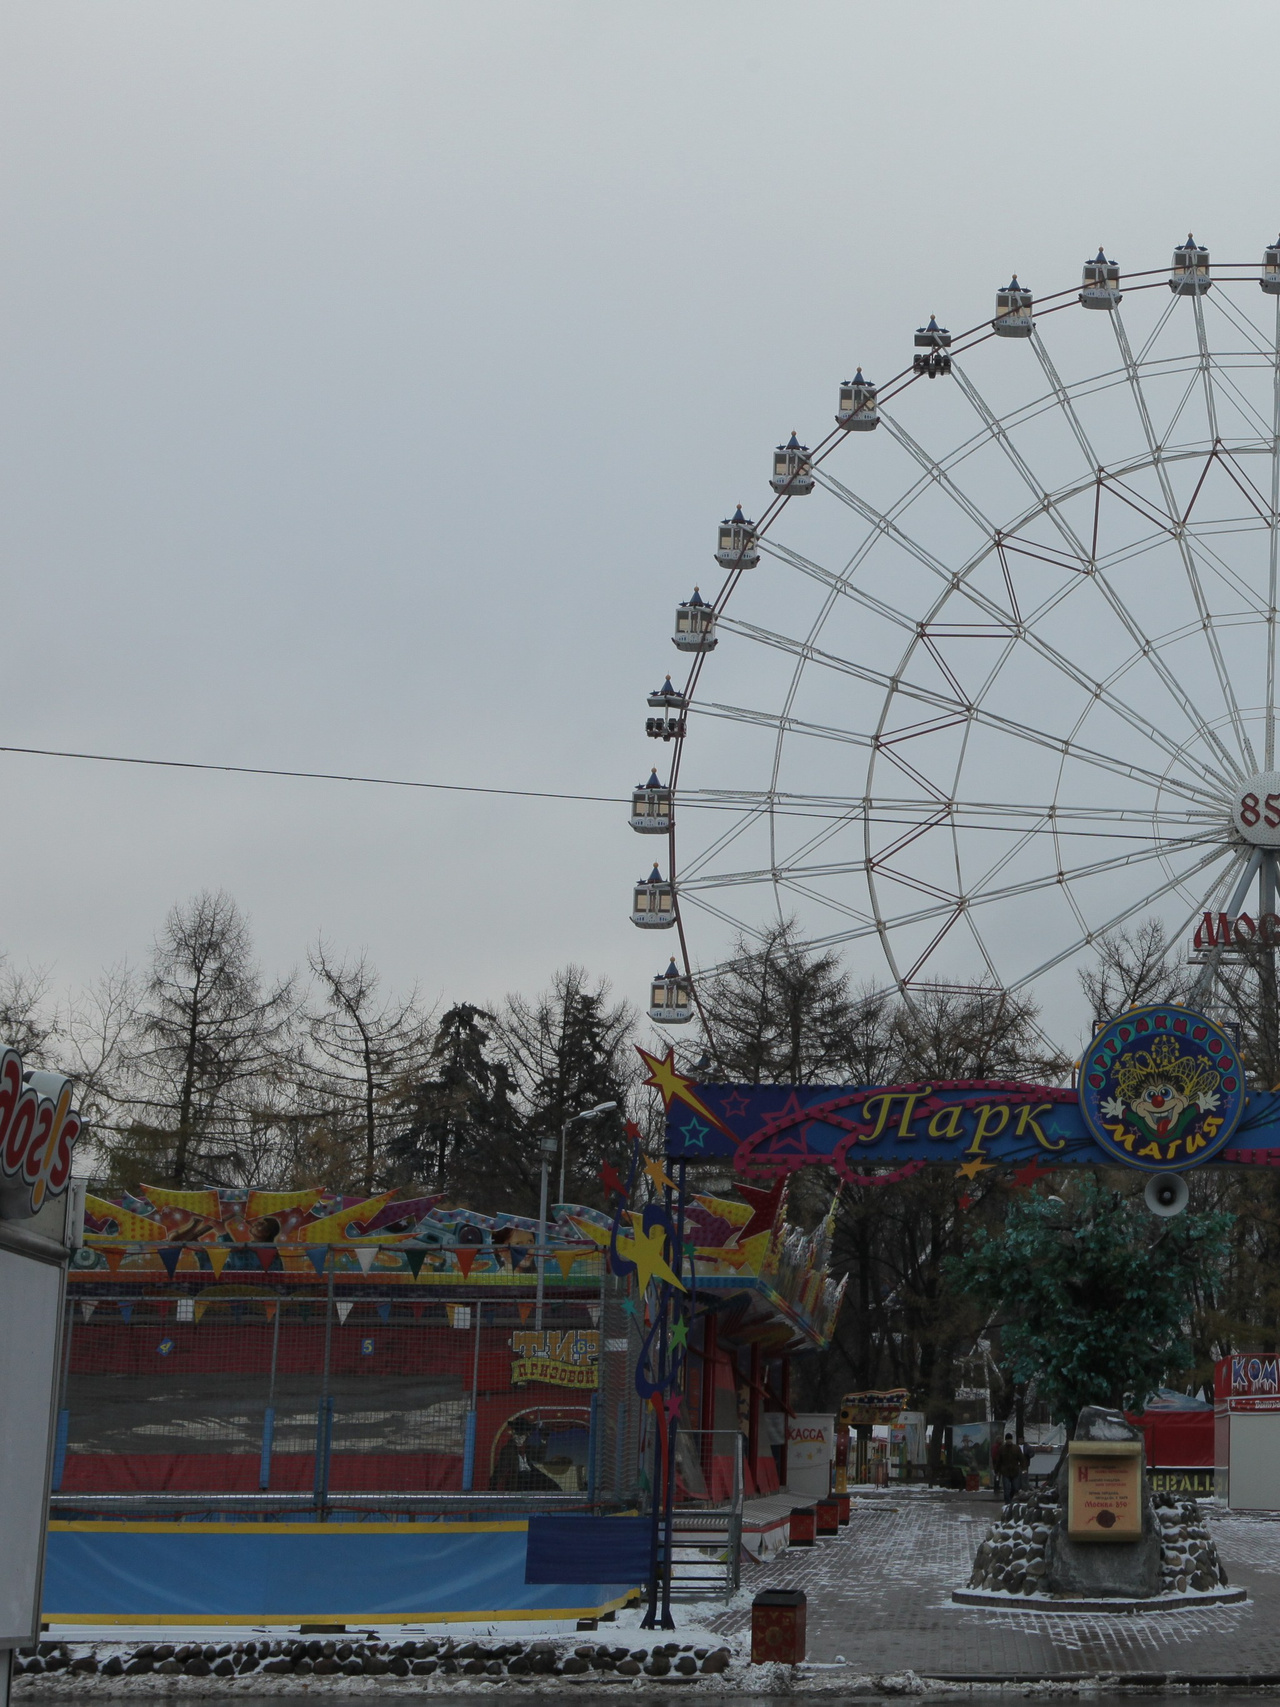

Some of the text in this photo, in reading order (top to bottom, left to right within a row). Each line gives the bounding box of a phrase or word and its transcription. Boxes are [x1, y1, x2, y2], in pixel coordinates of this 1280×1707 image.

[859, 1086, 1065, 1154] Парк
[1102, 1115, 1225, 1159] МАГИЯ
[364, 1340, 373, 1353] 5
[512, 1330, 600, 1366] ТИР
[577, 1340, 586, 1354] 6
[518, 1363, 595, 1384] ПРИЗОВОЙ
[787, 1428, 825, 1442] КАССА
